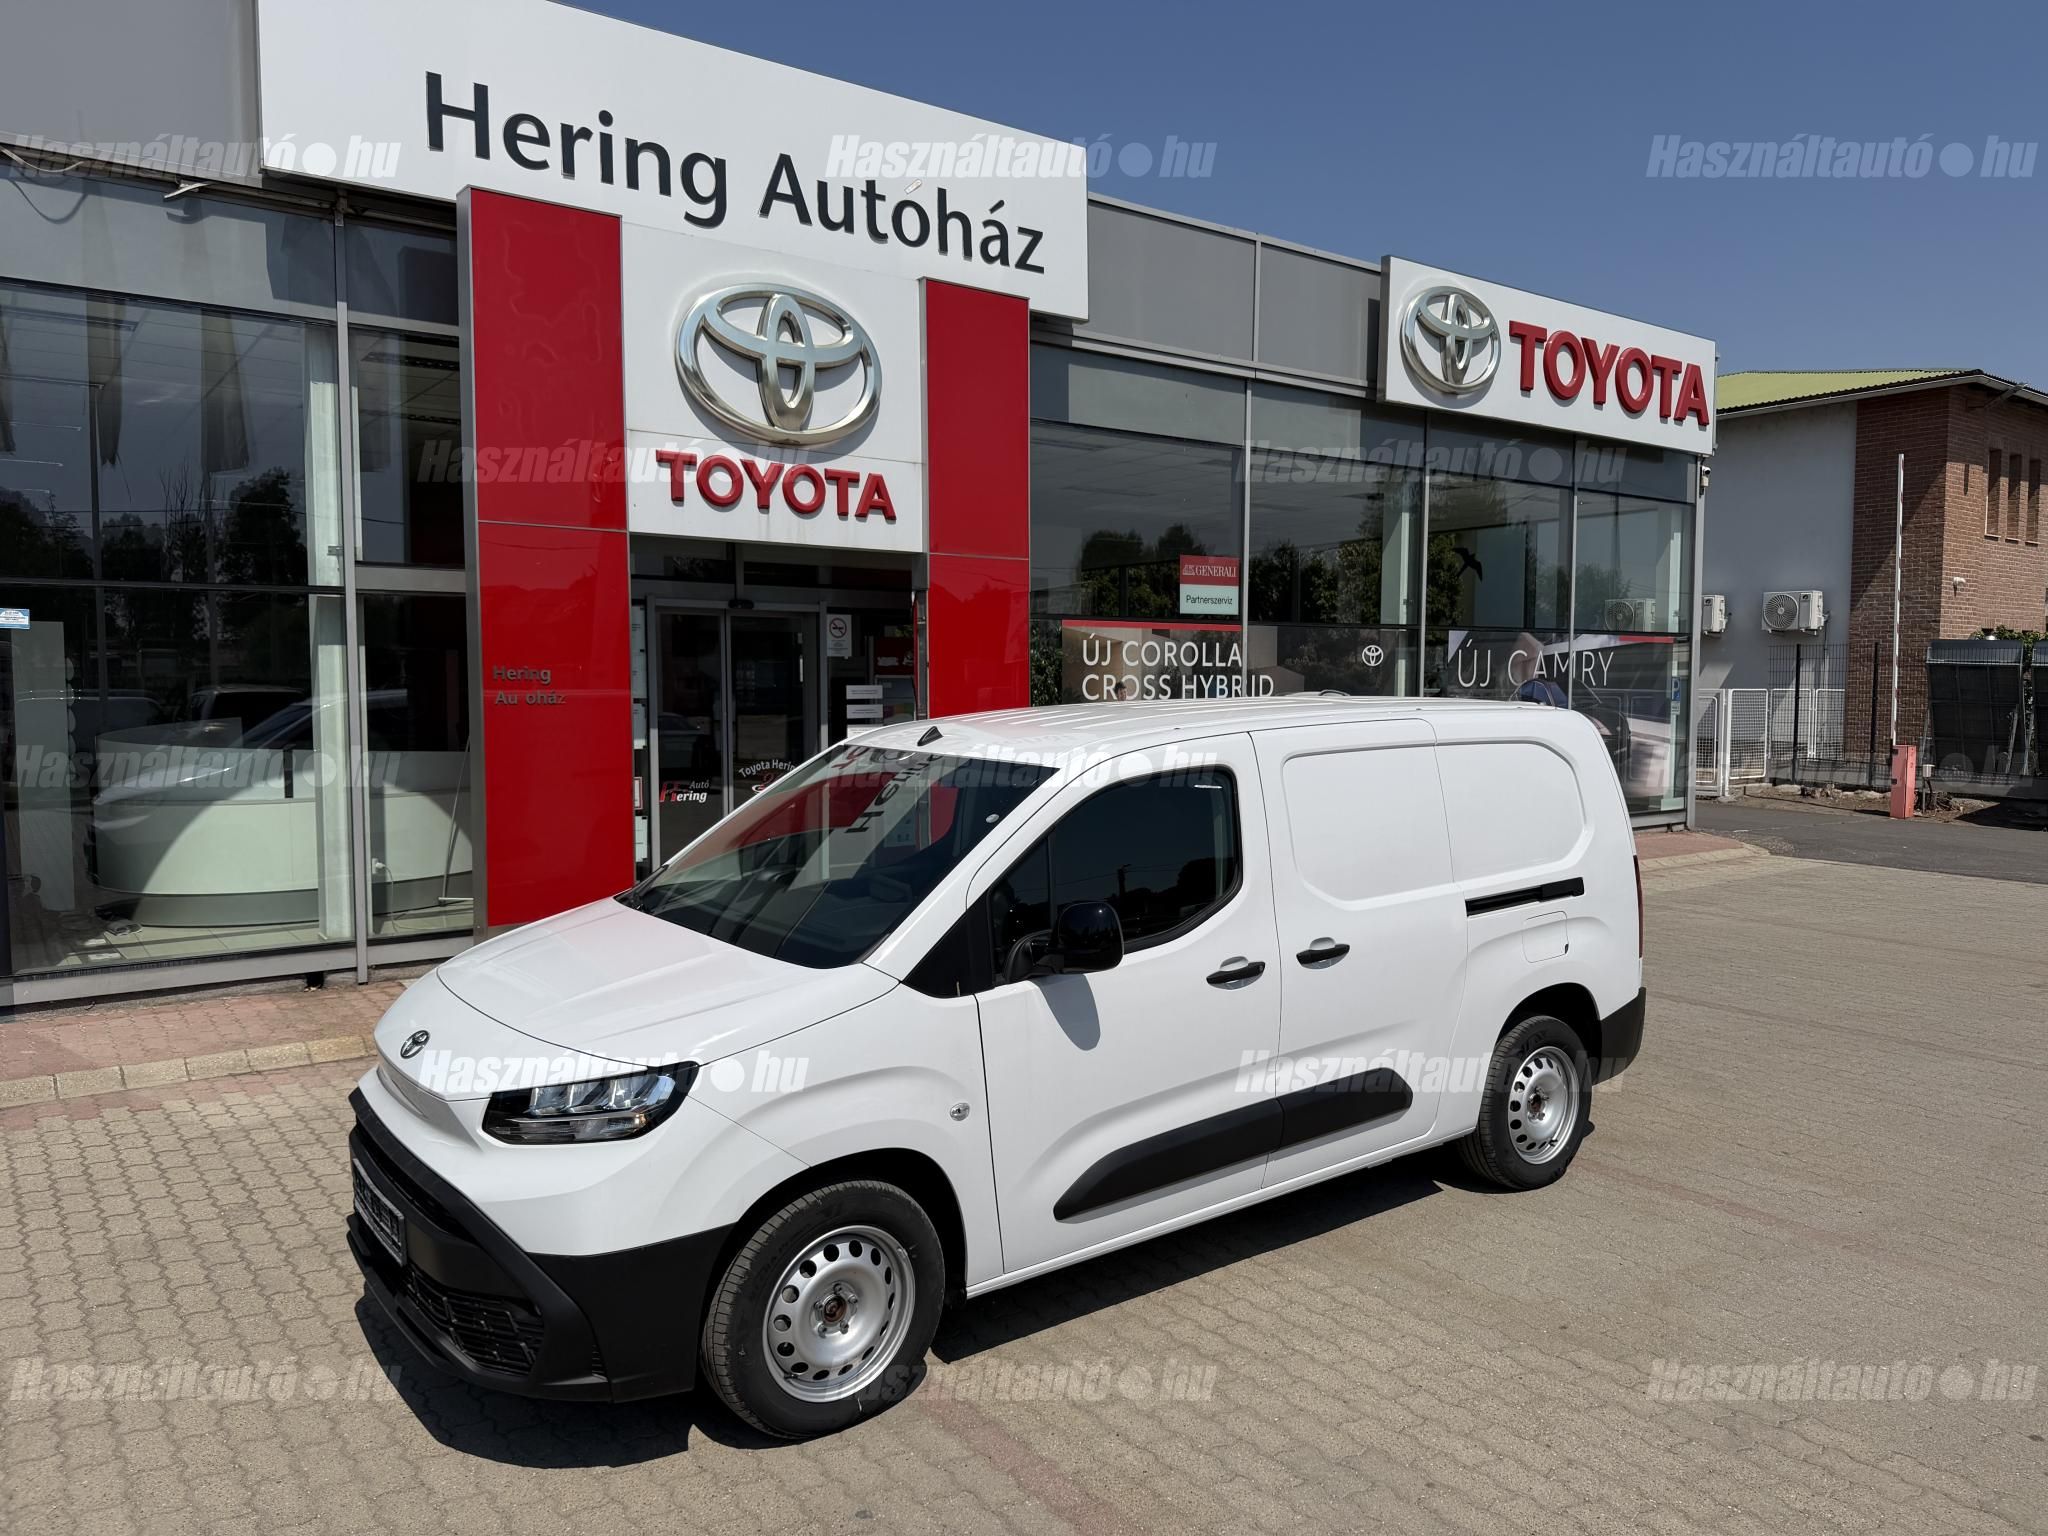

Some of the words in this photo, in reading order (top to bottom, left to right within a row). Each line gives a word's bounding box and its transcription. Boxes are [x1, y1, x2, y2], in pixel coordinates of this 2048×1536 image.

[425, 70, 728, 228] Hering
[758, 151, 1046, 275] Autóház
[1508, 320, 1711, 427] TOYOTA
[655, 447, 898, 521] TOYOTA
[1195, 565, 1237, 578] GENERALI
[1082, 632, 1112, 667] ÚJ
[1122, 640, 1243, 667] COROLLA
[1458, 639, 1491, 688] ÚJ
[1507, 649, 1614, 687] CAMRY
[493, 664, 552, 686] Hering
[1081, 673, 1173, 700] CROSS
[1181, 674, 1275, 700] HYBRID
[739, 761, 771, 778] Toyota
[772, 759, 798, 772] Herin
